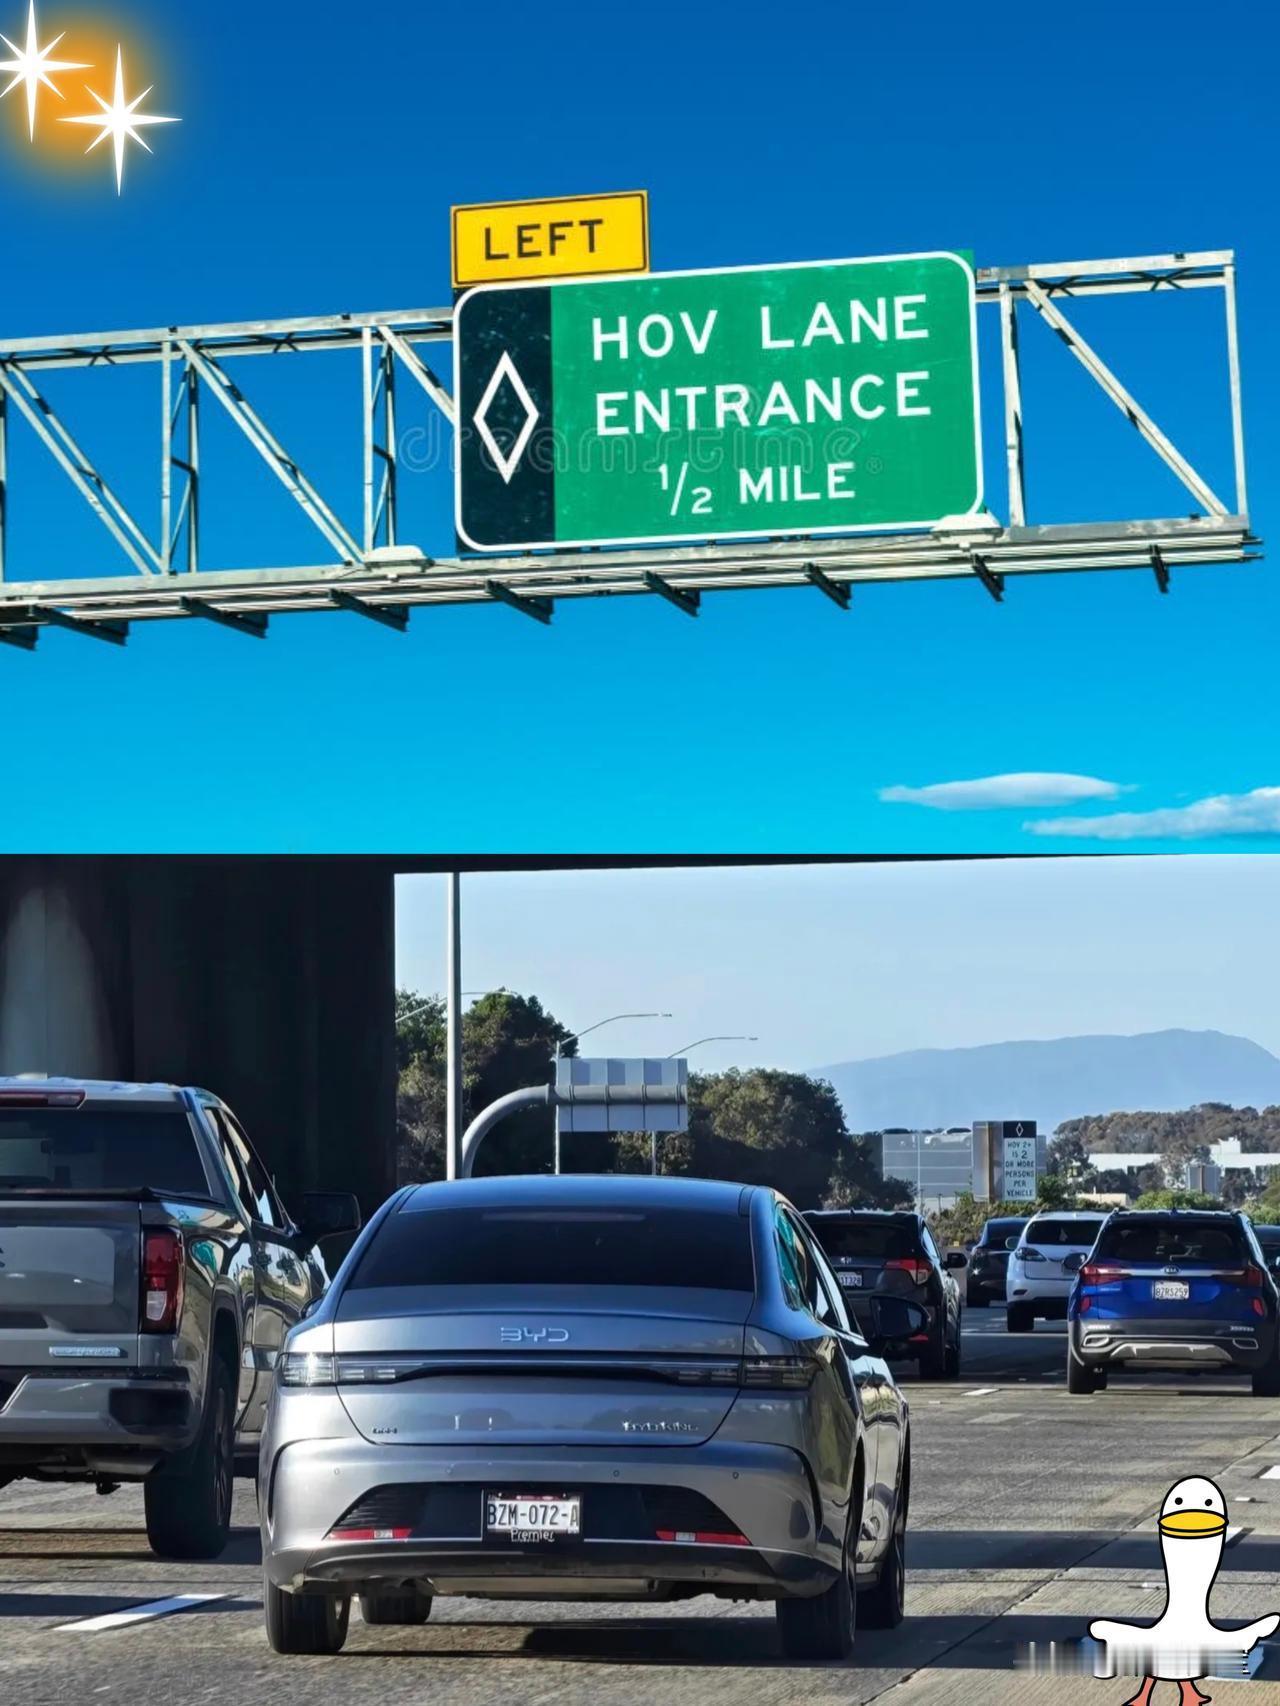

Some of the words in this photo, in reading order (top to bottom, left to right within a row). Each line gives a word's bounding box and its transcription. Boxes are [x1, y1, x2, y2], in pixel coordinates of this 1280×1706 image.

[484, 219, 604, 260] LEFT
[592, 309, 718, 361] HOV
[760, 294, 929, 349] LANE
[596, 370, 932, 437] ENTRANCE
[739, 462, 856, 503] MILE
[1005, 1160, 1014, 1168] OR
[1017, 1160, 1034, 1168] MORE
[1021, 1150, 1028, 1159] 2
[1005, 1170, 1034, 1178] PERSONS
[500, 1327, 569, 1342] BYD
[487, 1503, 579, 1526] BZM-072-A
